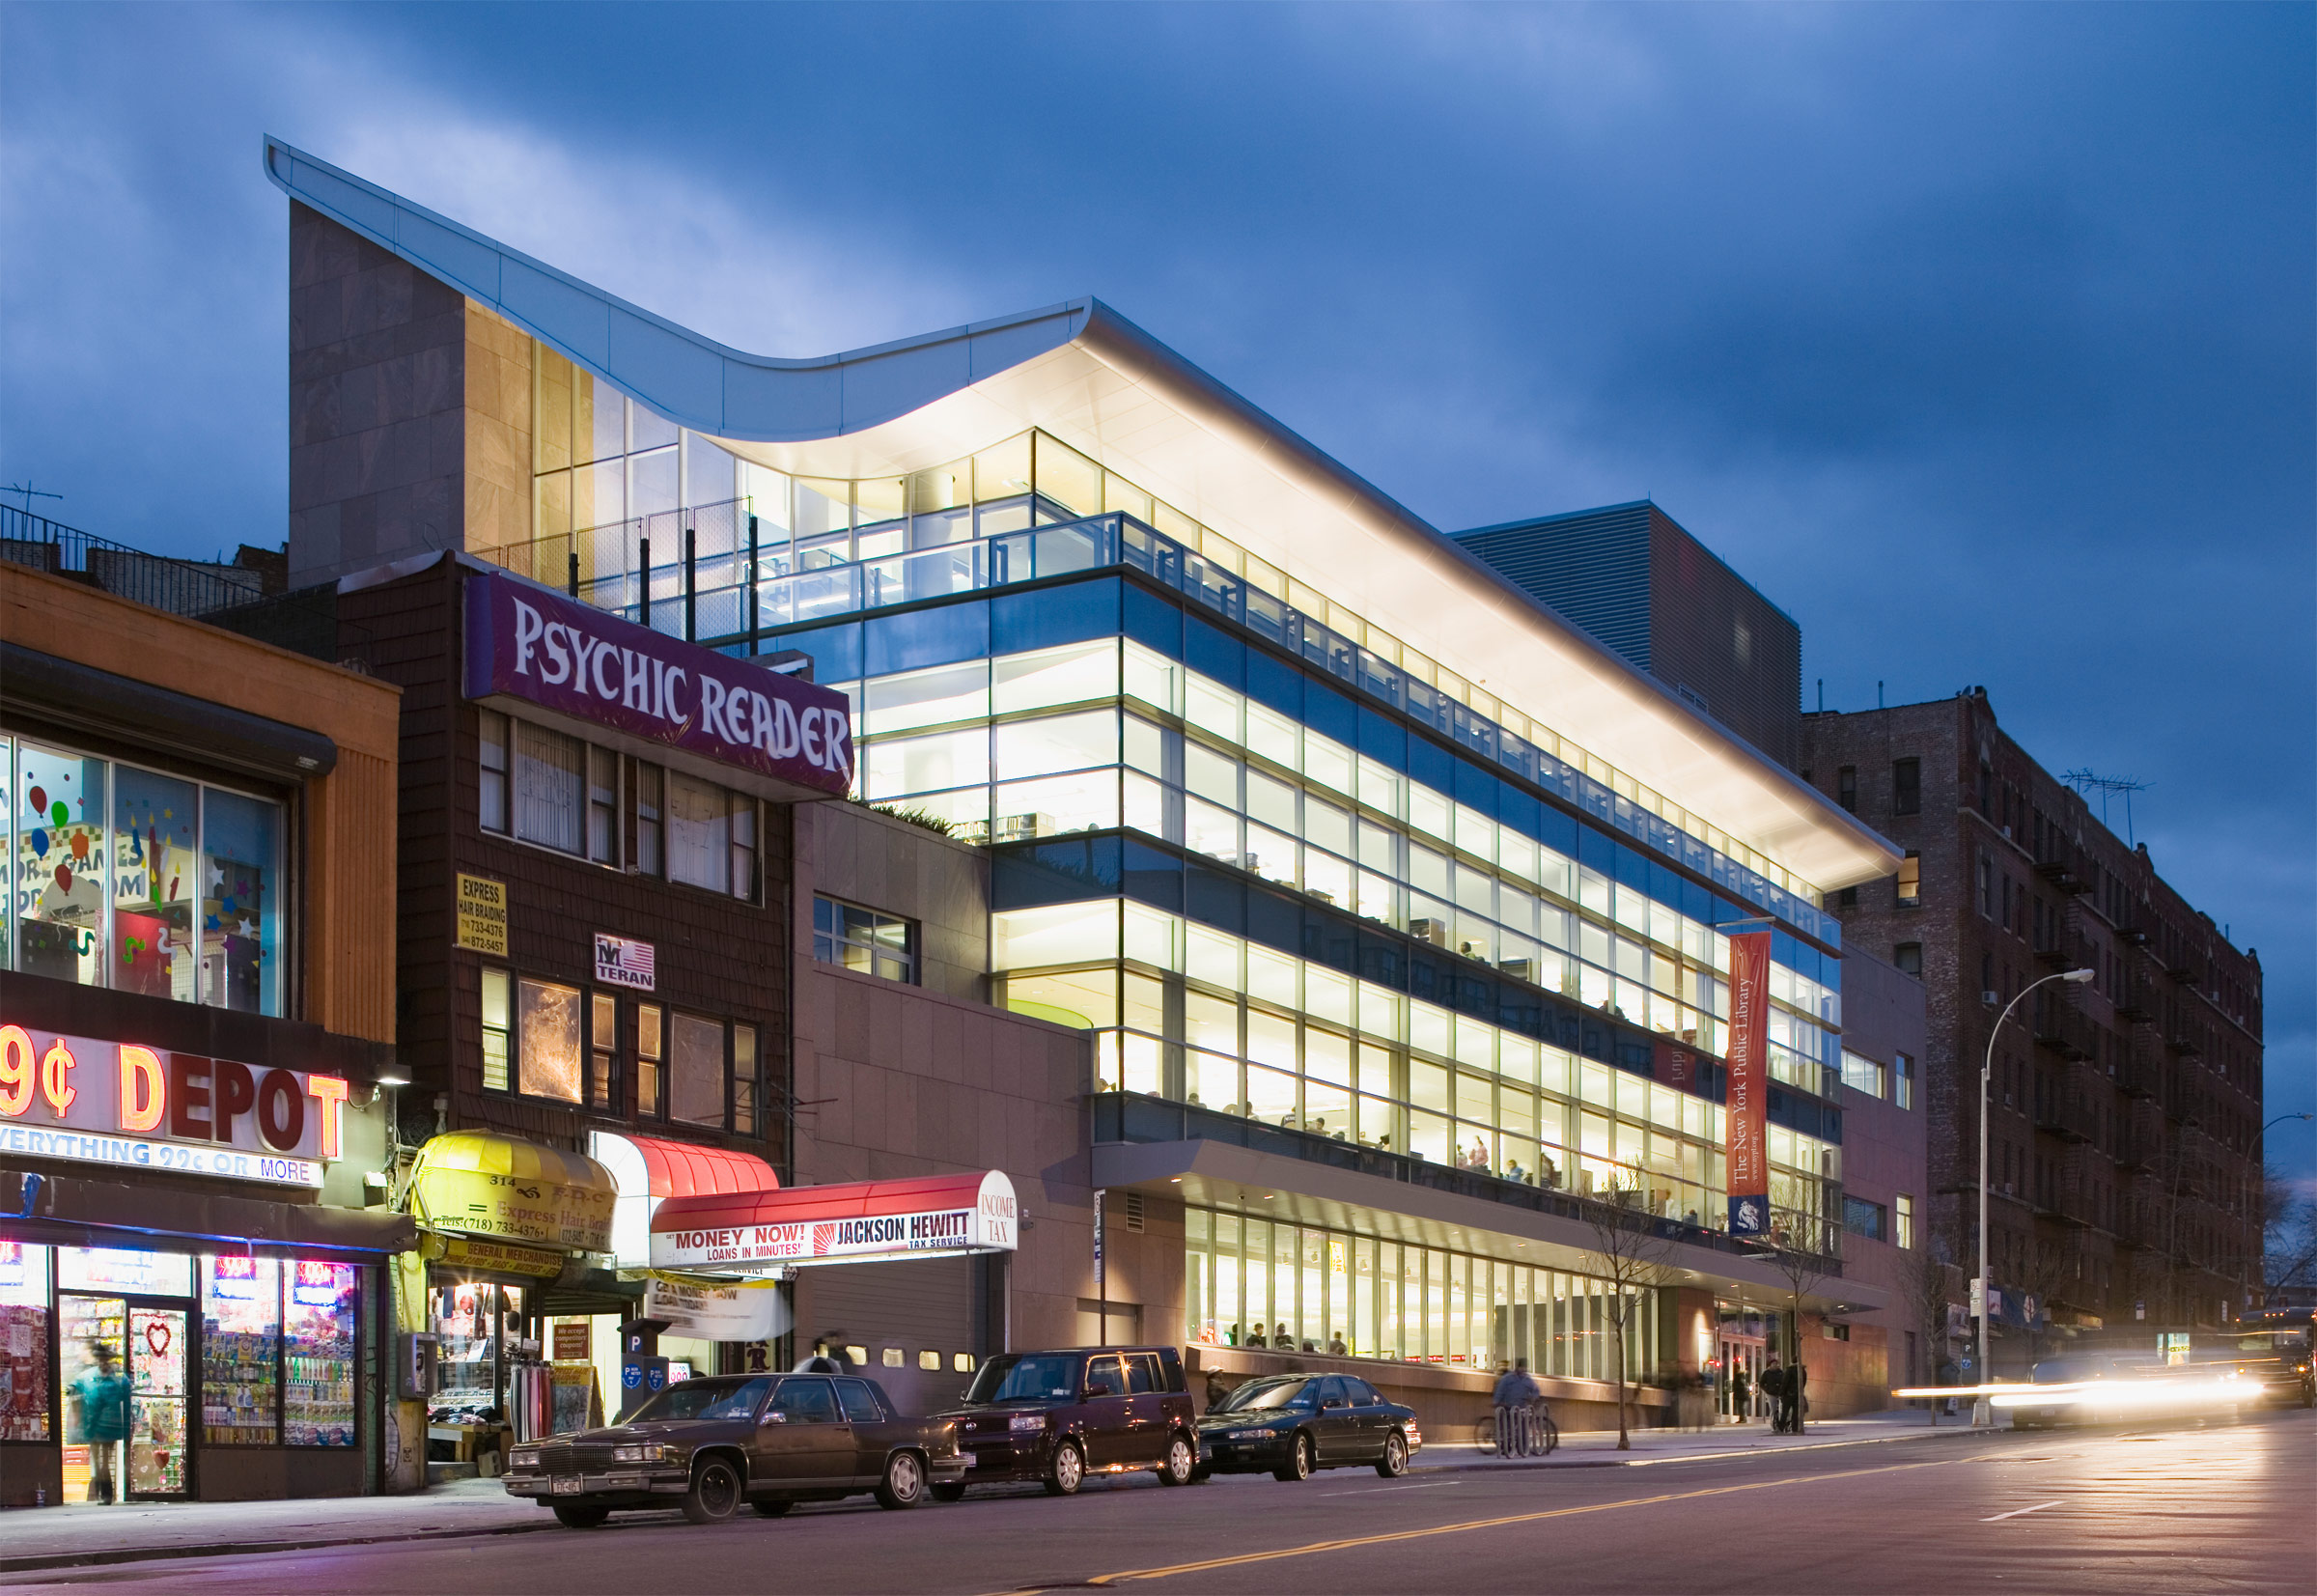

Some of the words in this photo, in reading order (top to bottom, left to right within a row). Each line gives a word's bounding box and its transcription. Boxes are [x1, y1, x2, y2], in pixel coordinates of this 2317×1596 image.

[513, 596, 687, 725] PSYCHIC
[699, 673, 851, 787] READER
[463, 880, 499, 904] EXPRESS
[459, 899, 474, 916] HAIR
[475, 902, 505, 923] BRAIDING
[471, 920, 503, 938] 733-4376
[471, 936, 503, 953] 872-5457
[598, 966, 653, 986] TERAN
[1735, 977, 1753, 1028] Library
[1733, 1033, 1747, 1078] Public
[119, 1044, 349, 1158] DEPOT
[1733, 1081, 1746, 1114] York
[1733, 1118, 1746, 1151] New
[213, 1154, 248, 1175] OR
[261, 1158, 310, 1181] MORE
[1734, 1155, 1747, 1184] The
[489, 1176, 516, 1188] 314
[496, 1200, 556, 1224] Express
[560, 1210, 585, 1227] Hair
[981, 1193, 1015, 1218] INCOME
[677, 1229, 743, 1248] MONEY
[755, 1223, 805, 1244] NOW!
[838, 1218, 905, 1245] JACKSON
[910, 1212, 969, 1239] HEWITT
[987, 1220, 1008, 1243] TAX
[708, 1247, 738, 1261] LOANS
[742, 1246, 751, 1258] IN
[908, 1240, 927, 1248] TAX
[930, 1236, 968, 1247] SERVICE
[468, 1244, 503, 1259] GENERAL
[506, 1246, 562, 1266] MERCHANDISE
[631, 1336, 641, 1351] P
[625, 1367, 630, 1376] P
